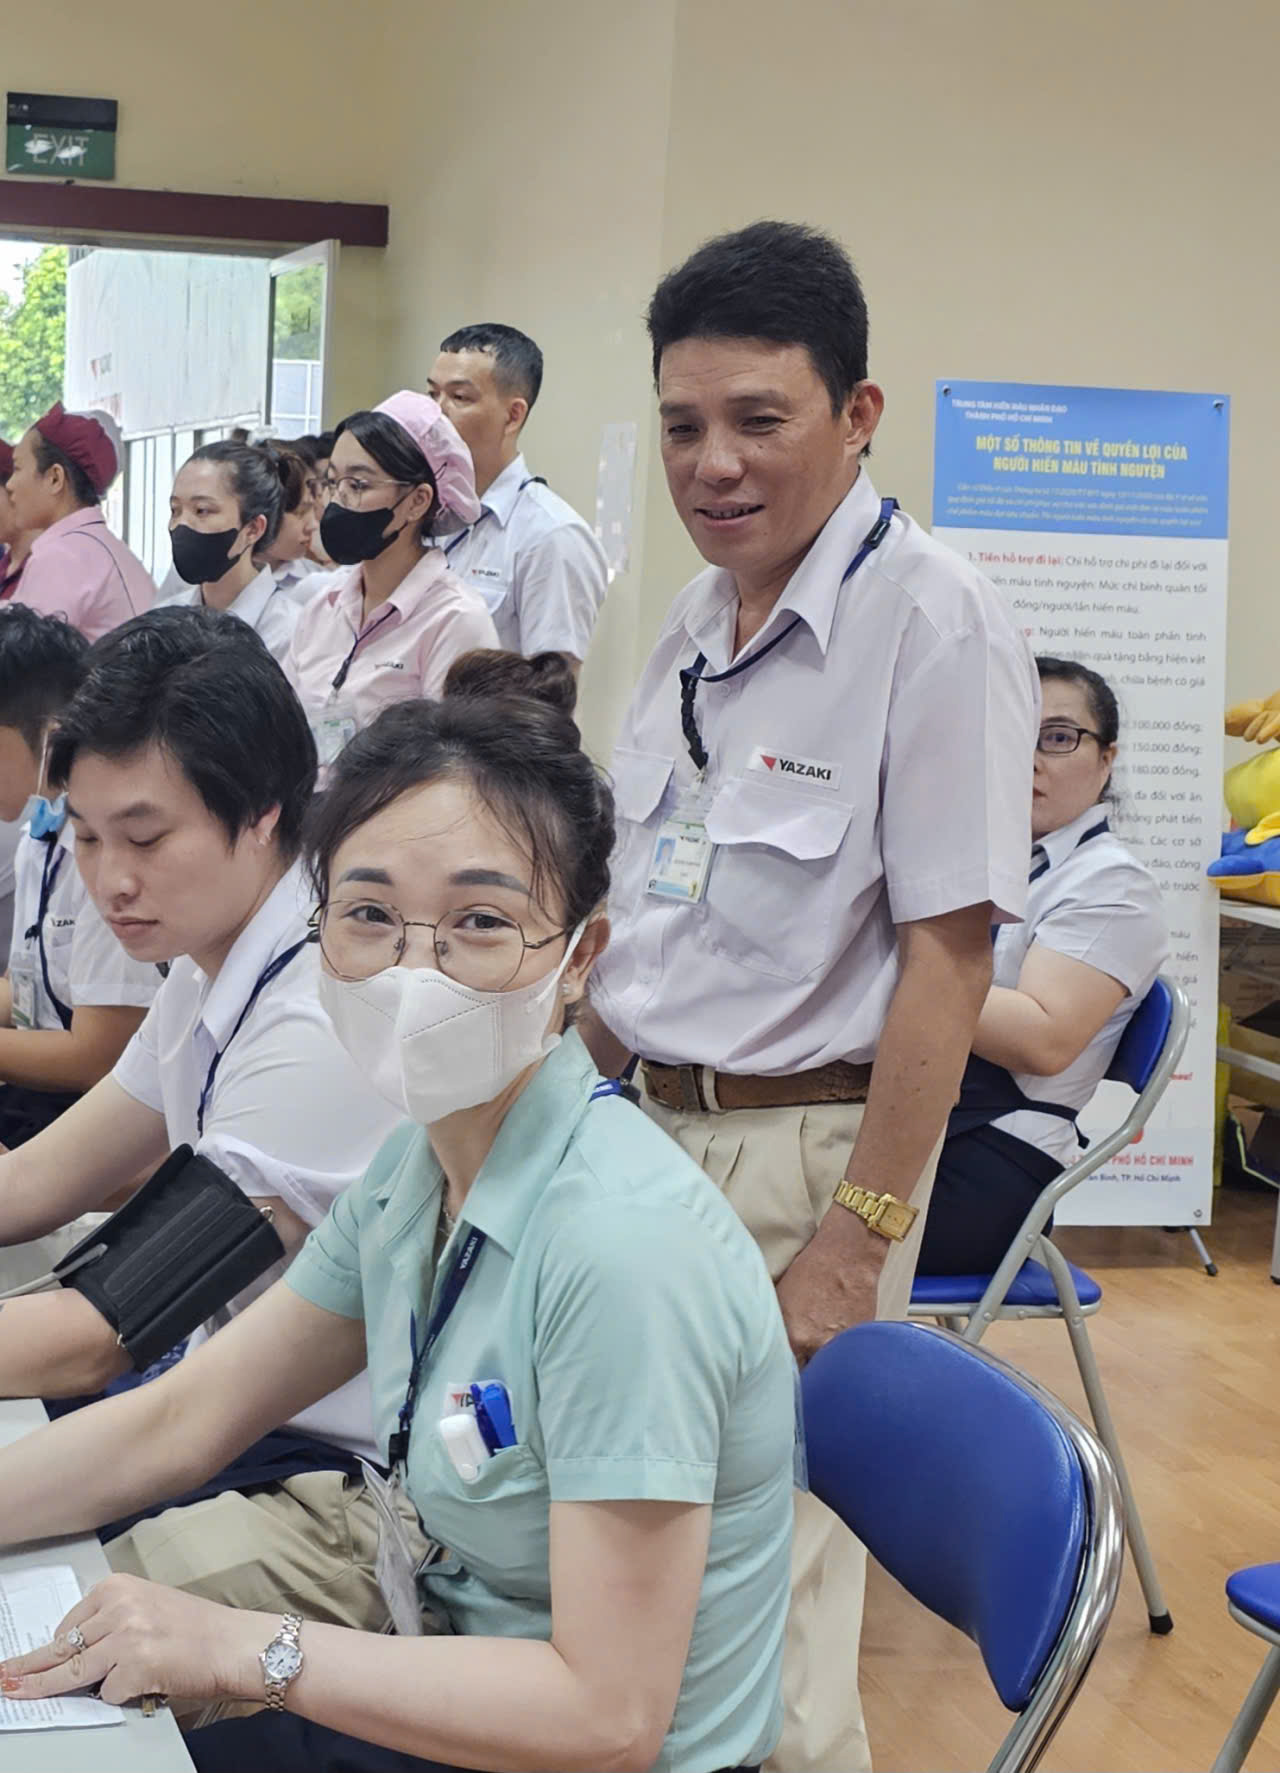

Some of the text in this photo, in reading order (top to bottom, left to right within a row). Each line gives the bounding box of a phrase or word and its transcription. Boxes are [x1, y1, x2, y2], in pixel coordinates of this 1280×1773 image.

[32, 132, 89, 167] EXIT
[976, 433, 1002, 453] MỘT
[1022, 435, 1060, 454] THÔNG
[1064, 439, 1082, 455] TIN
[1163, 441, 1188, 461] CỦA
[1031, 455, 1059, 473] HIẾN
[779, 758, 832, 781] YAZAKI
